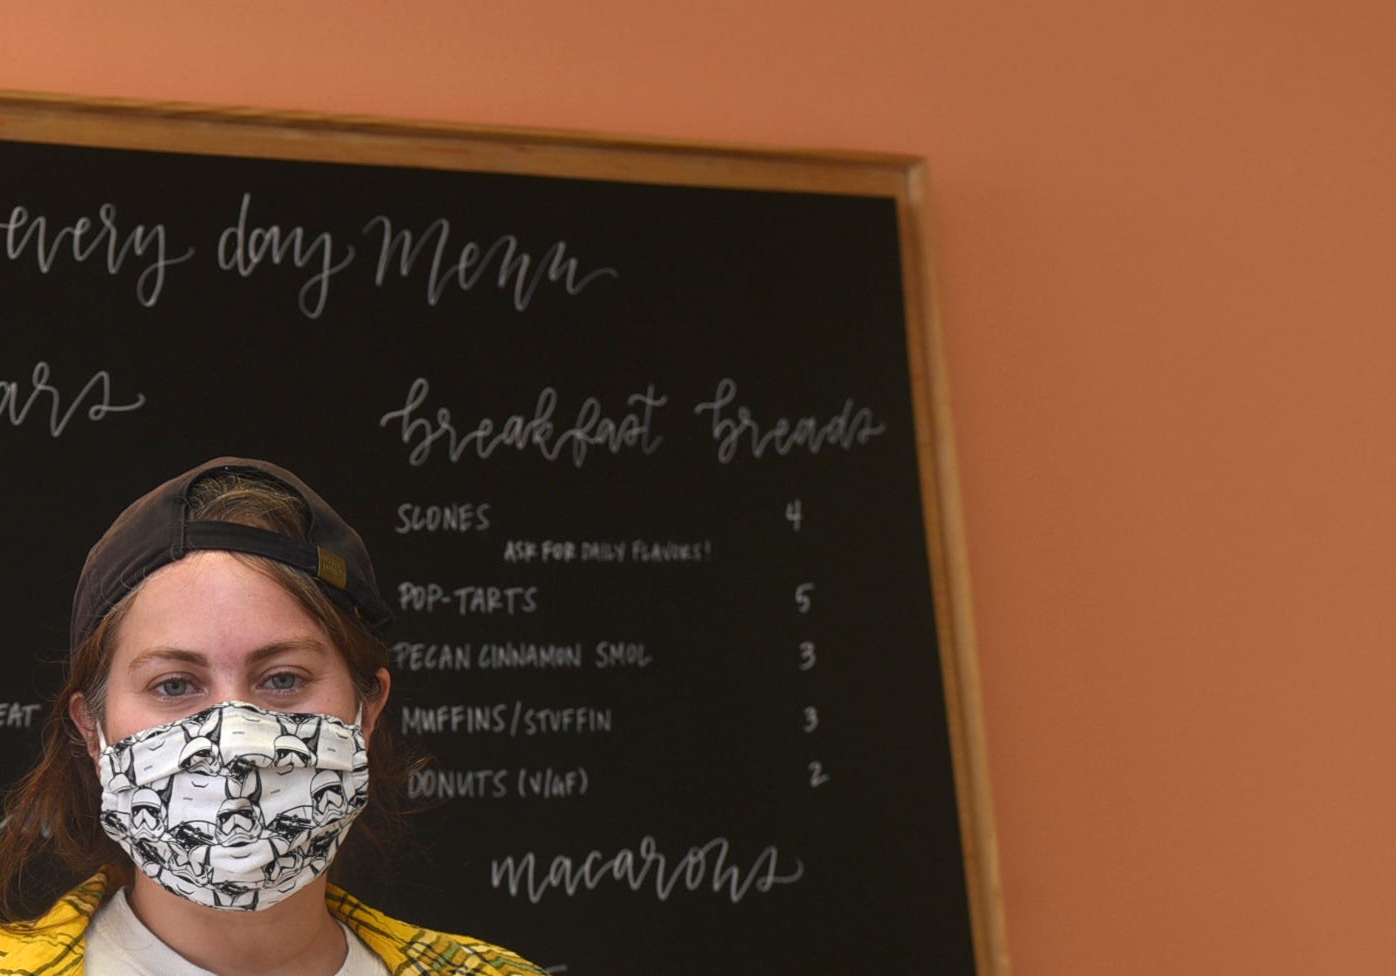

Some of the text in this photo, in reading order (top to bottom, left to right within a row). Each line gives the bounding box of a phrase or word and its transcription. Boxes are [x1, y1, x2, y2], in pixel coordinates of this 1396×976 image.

[218, 193, 353, 318] day
[380, 378, 886, 466] breakfast breads
[786, 500, 802, 530] 4
[542, 541, 575, 560] FOR
[398, 582, 813, 614] POP-TARTS 5
[393, 640, 471, 671] PECAN
[479, 643, 581, 668] CINNAMON
[800, 642, 816, 670] 3
[805, 707, 818, 732] 3
[408, 768, 509, 799] DONUTS
[809, 762, 828, 787] 2
[492, 836, 803, 903] macarons
